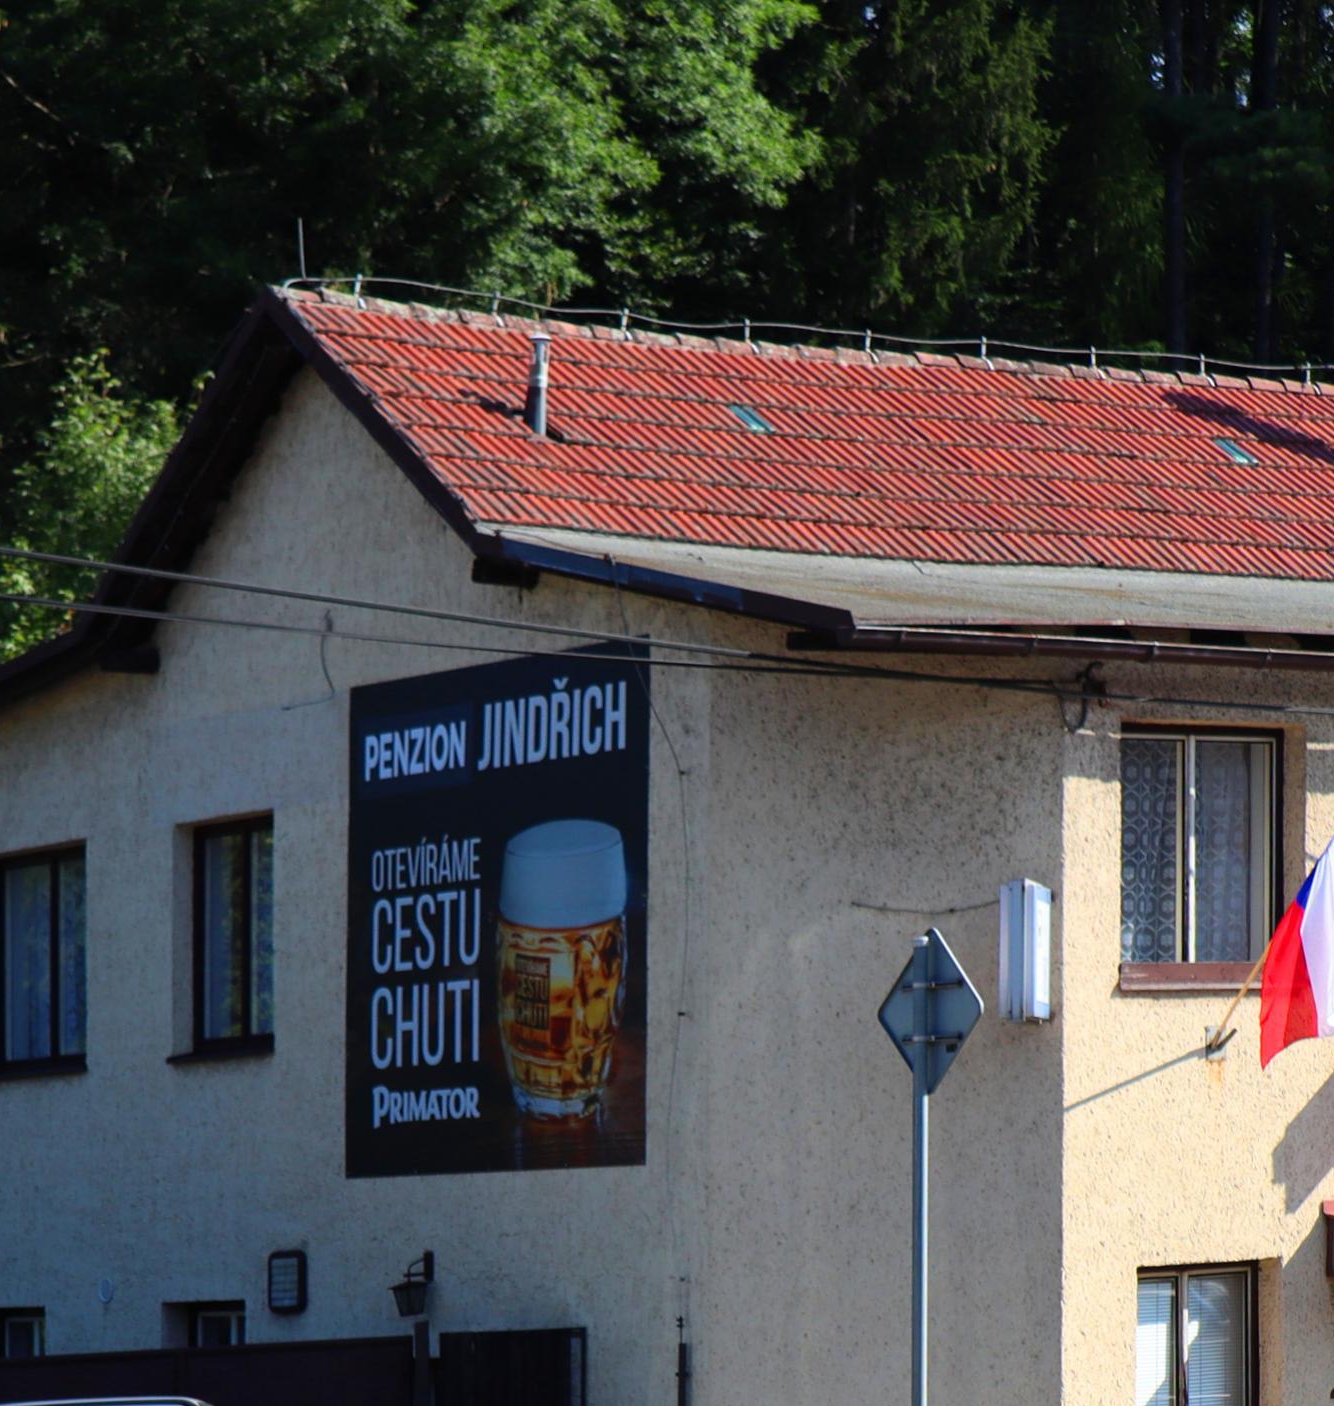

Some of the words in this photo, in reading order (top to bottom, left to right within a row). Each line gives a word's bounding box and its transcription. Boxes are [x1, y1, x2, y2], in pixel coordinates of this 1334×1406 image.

[365, 720, 466, 782] PENZION
[477, 677, 627, 771] JINDŘICH
[372, 834, 481, 892] OTEVÍRÁME
[372, 888, 481, 974] CESTU
[371, 979, 480, 1070] CHUTI
[372, 1086, 481, 1129] PRIMATOR
